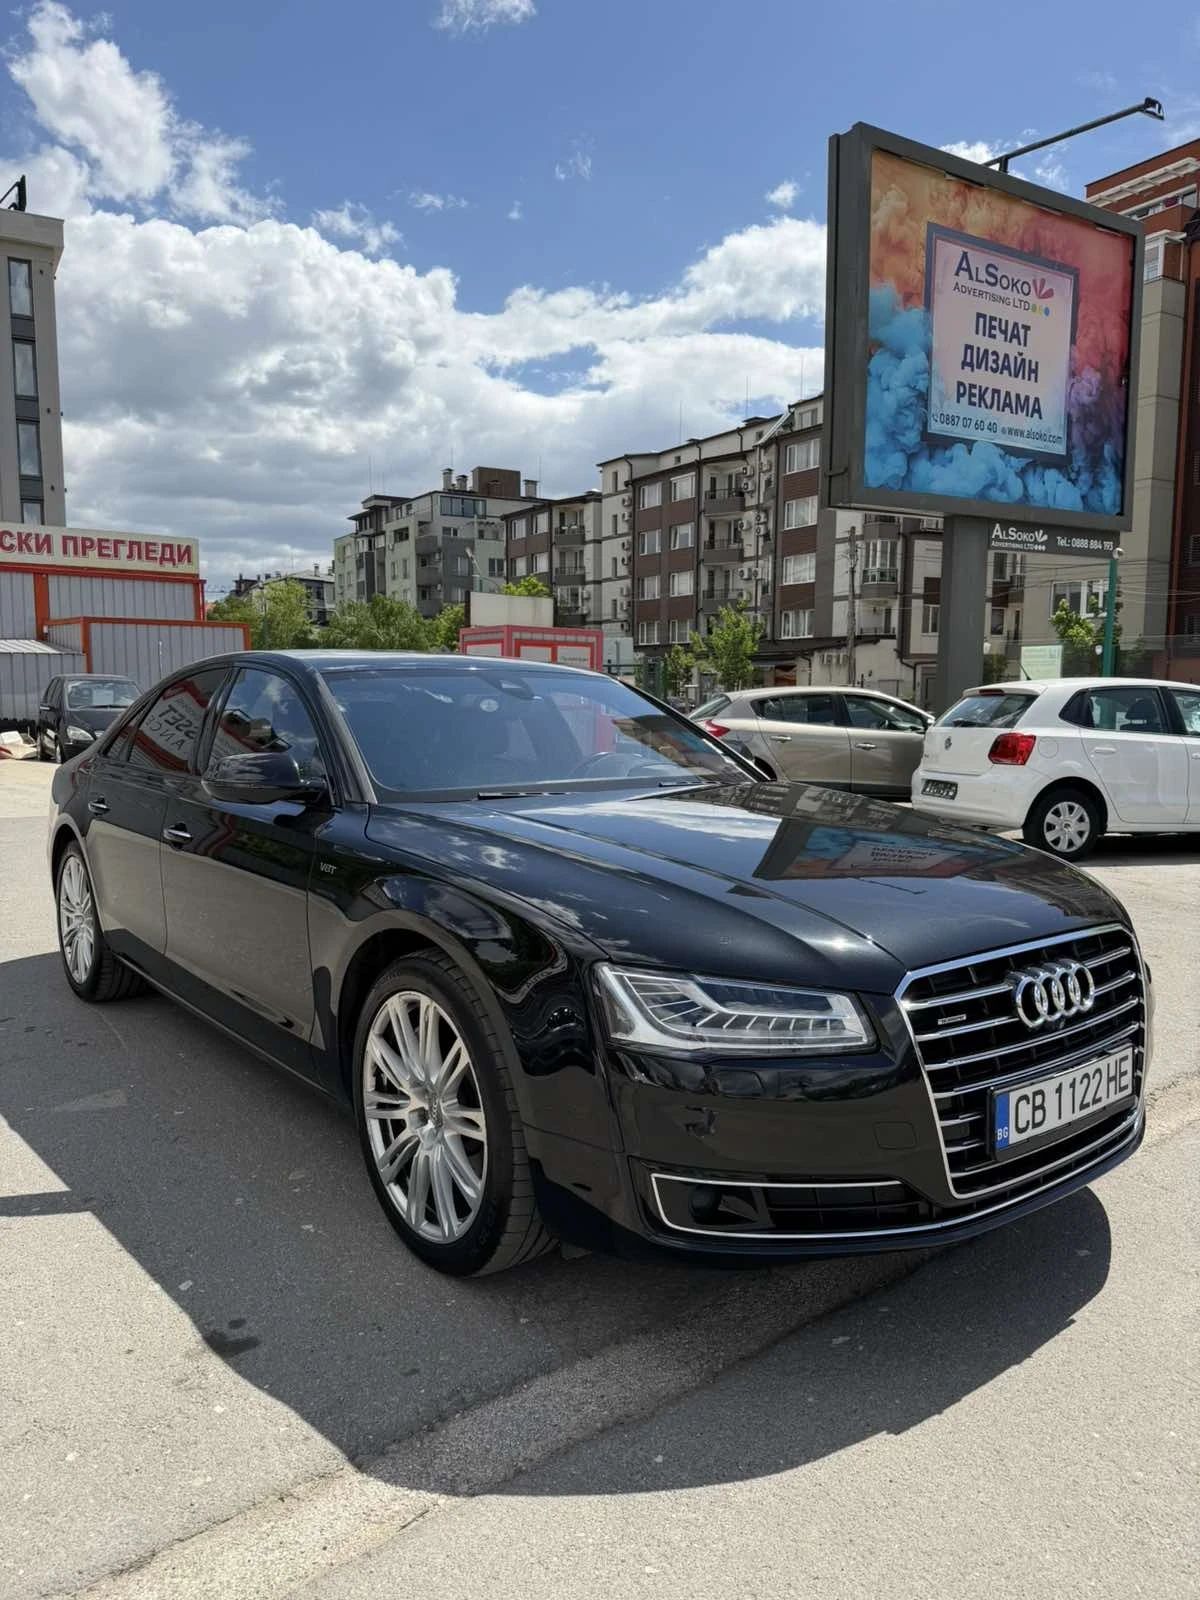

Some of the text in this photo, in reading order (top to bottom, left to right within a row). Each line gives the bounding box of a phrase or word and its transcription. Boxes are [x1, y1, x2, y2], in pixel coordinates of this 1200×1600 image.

[953, 281, 1030, 311] ADVERTISING LTD
[975, 311, 1031, 348] ПЕЧАТ
[960, 343, 1039, 384] ДИЗАЙН
[956, 380, 1043, 420] РЕКЛАМА
[939, 412, 998, 433] 0887 07 60 40
[1007, 426, 1063, 445] www.alsoko.com
[0, 530, 193, 566] СКИ ПРЕГЛЕДИ
[1071, 538, 1088, 549] 0888
[1089, 540, 1102, 549] 884
[1014, 1055, 1130, 1134] CB 1122 HE
[996, 1126, 1009, 1141] BG
